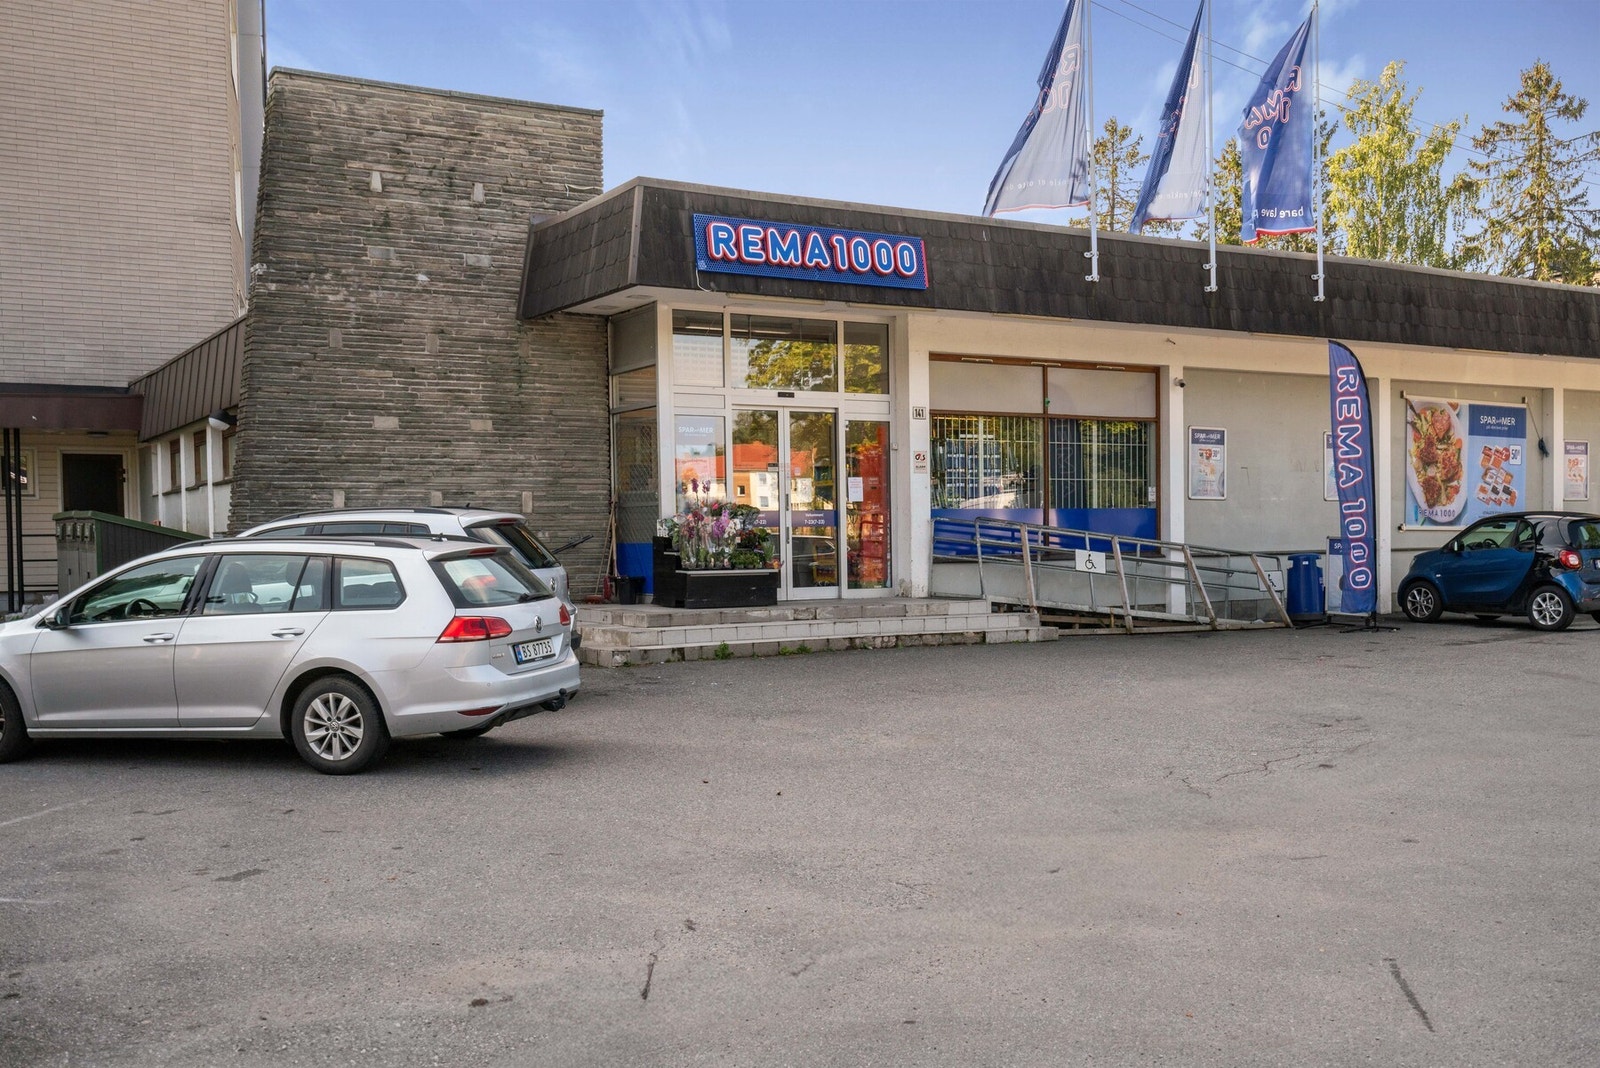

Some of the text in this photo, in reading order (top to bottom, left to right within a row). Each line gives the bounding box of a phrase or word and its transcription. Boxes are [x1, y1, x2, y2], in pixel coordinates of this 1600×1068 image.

[914, 408, 924, 418] 141
[1480, 415, 1516, 426] SPAR MER
[1337, 366, 1372, 590] REMA 1000
[1440, 509, 1455, 518] 1000
[522, 645, 532, 658] BS
